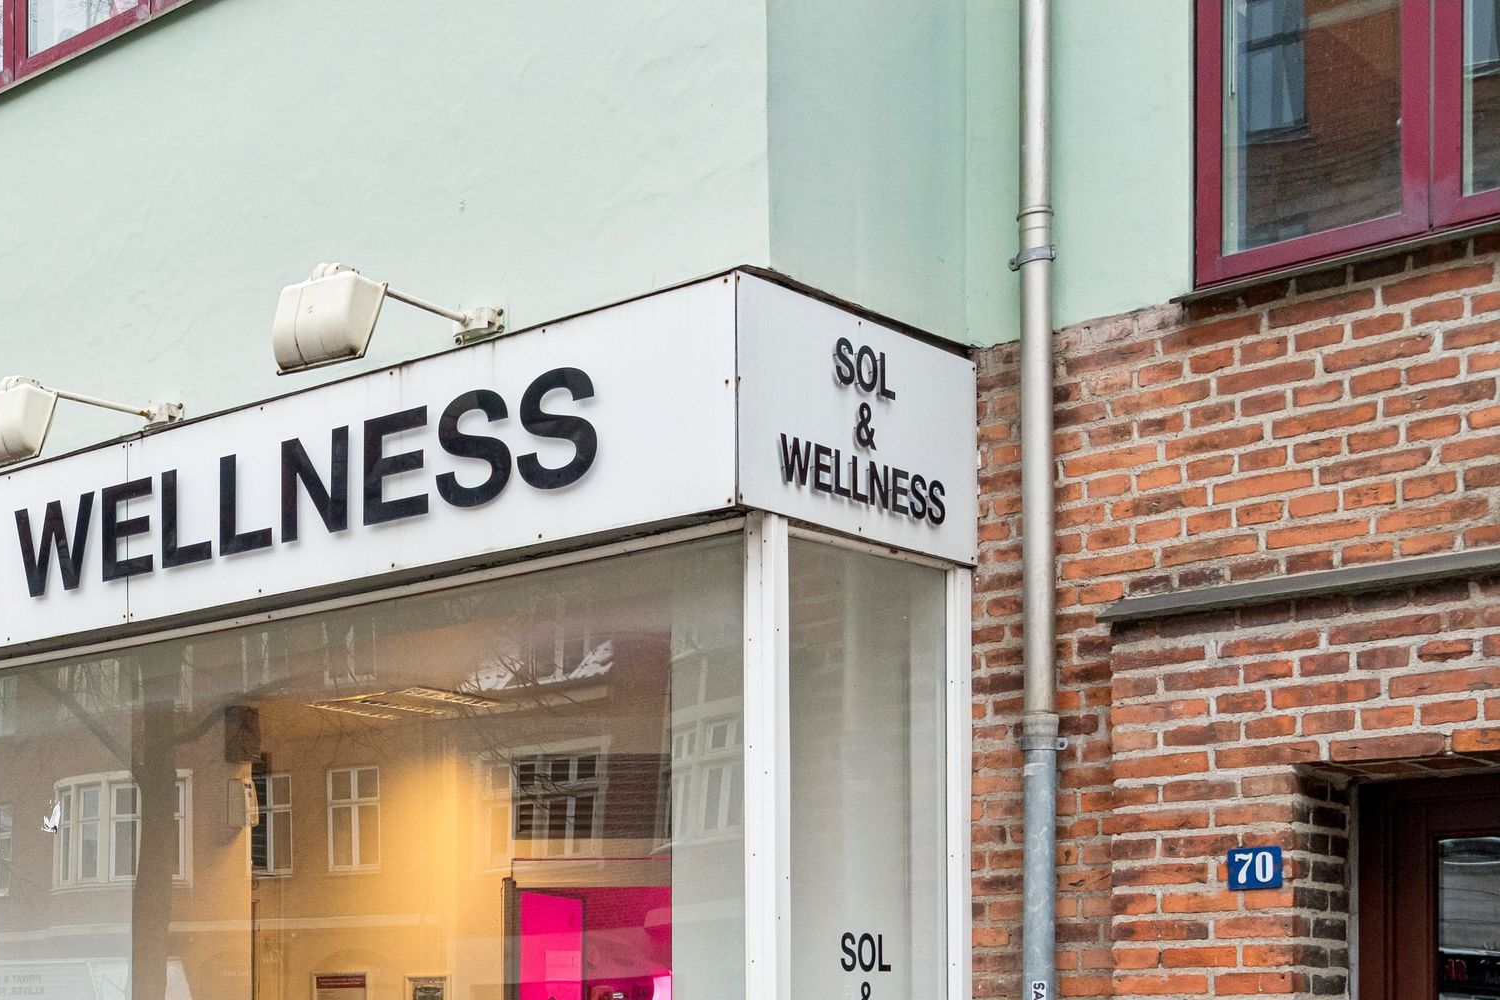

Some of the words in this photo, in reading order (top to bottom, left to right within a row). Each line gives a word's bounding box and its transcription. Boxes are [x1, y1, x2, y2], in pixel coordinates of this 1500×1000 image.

[835, 337, 895, 401] SOL
[856, 402, 877, 451] &
[14, 366, 598, 597] WELLNESS
[780, 432, 946, 525] WELLNESS
[1234, 851, 1273, 884] 70
[840, 932, 891, 972] SOL
